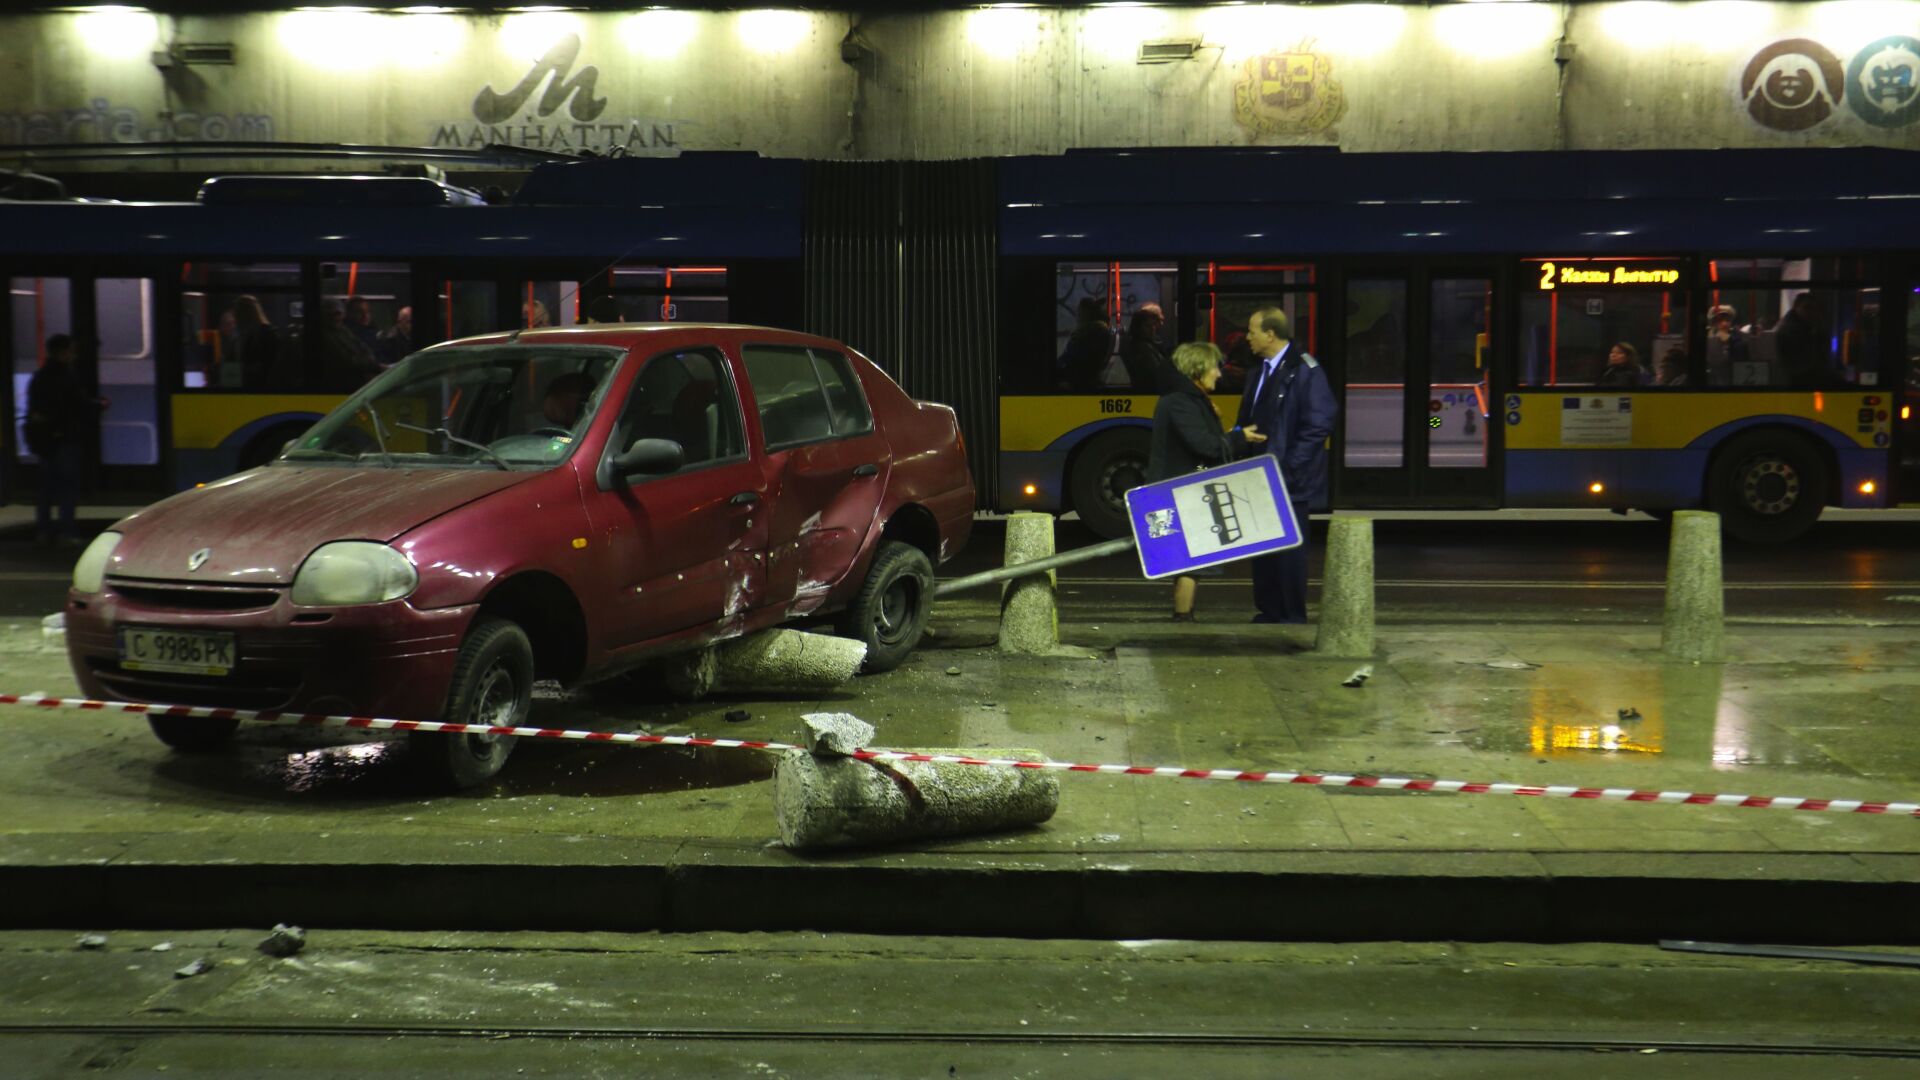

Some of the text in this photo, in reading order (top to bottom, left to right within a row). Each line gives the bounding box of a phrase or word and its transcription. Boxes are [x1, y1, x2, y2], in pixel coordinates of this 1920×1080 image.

[432, 124, 677, 148] MANHATTAN
[1540, 262, 1555, 289] 2
[1099, 399, 1132, 413] 1662
[133, 633, 147, 658] C
